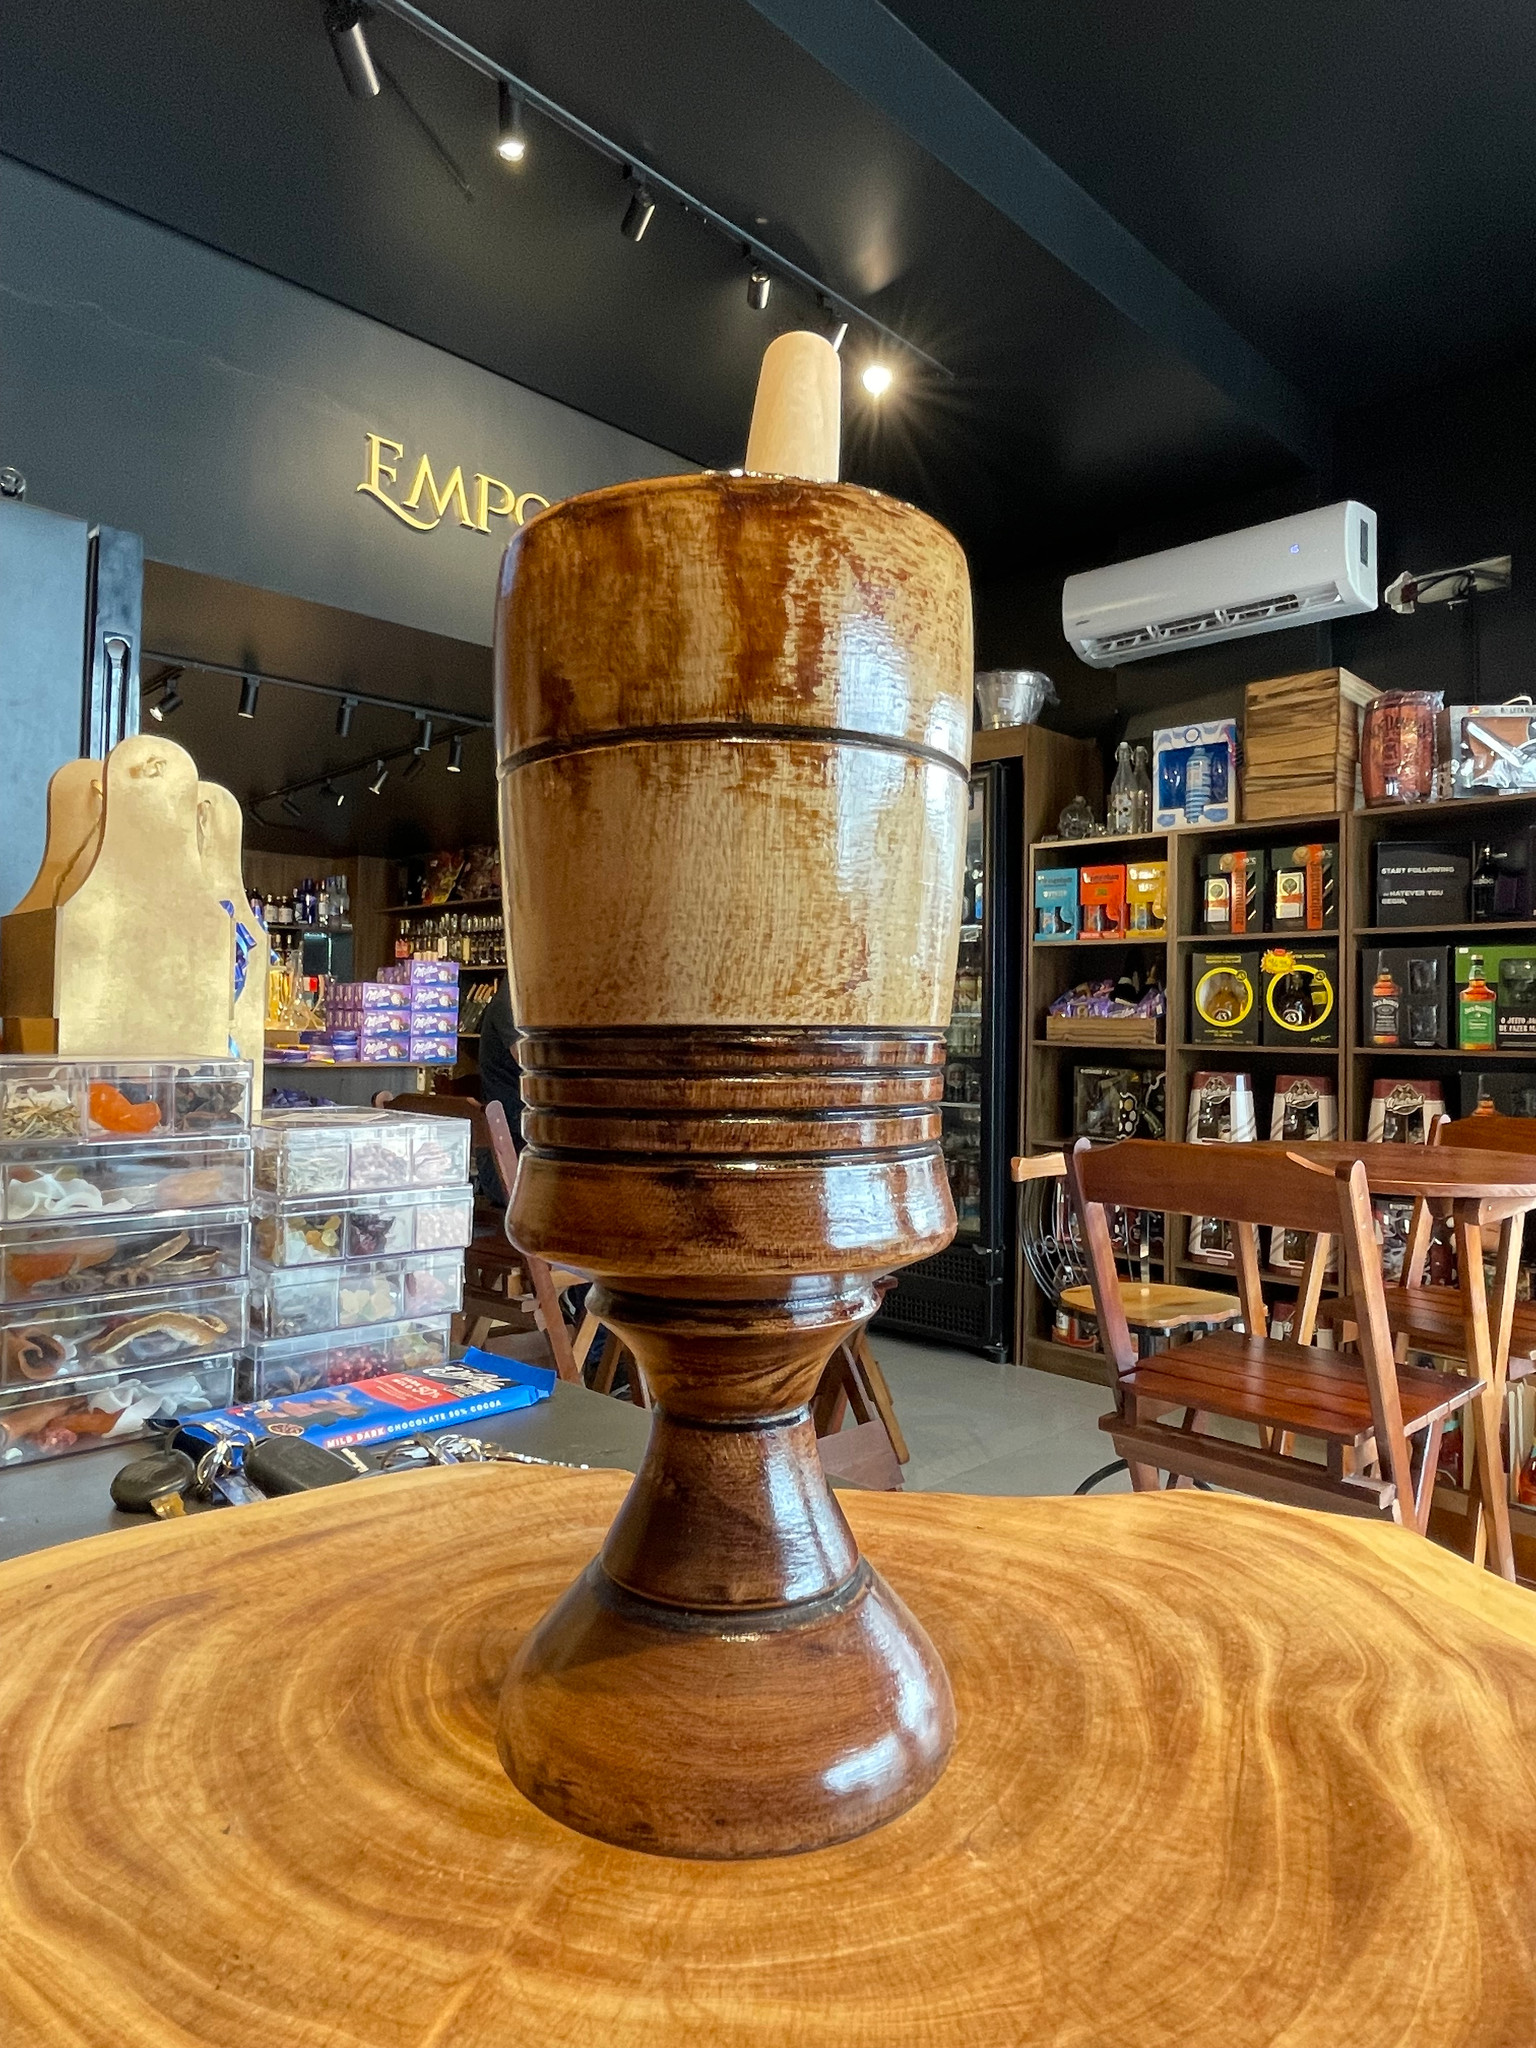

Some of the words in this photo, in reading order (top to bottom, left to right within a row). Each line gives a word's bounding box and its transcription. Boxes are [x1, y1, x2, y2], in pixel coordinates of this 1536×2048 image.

[1407, 866, 1455, 874] FOLLOWING
[326, 1435, 353, 1449] MILD
[357, 1427, 384, 1441] DARK
[387, 1412, 446, 1433] CHOCOLATE
[470, 1399, 502, 1413] COCOA
